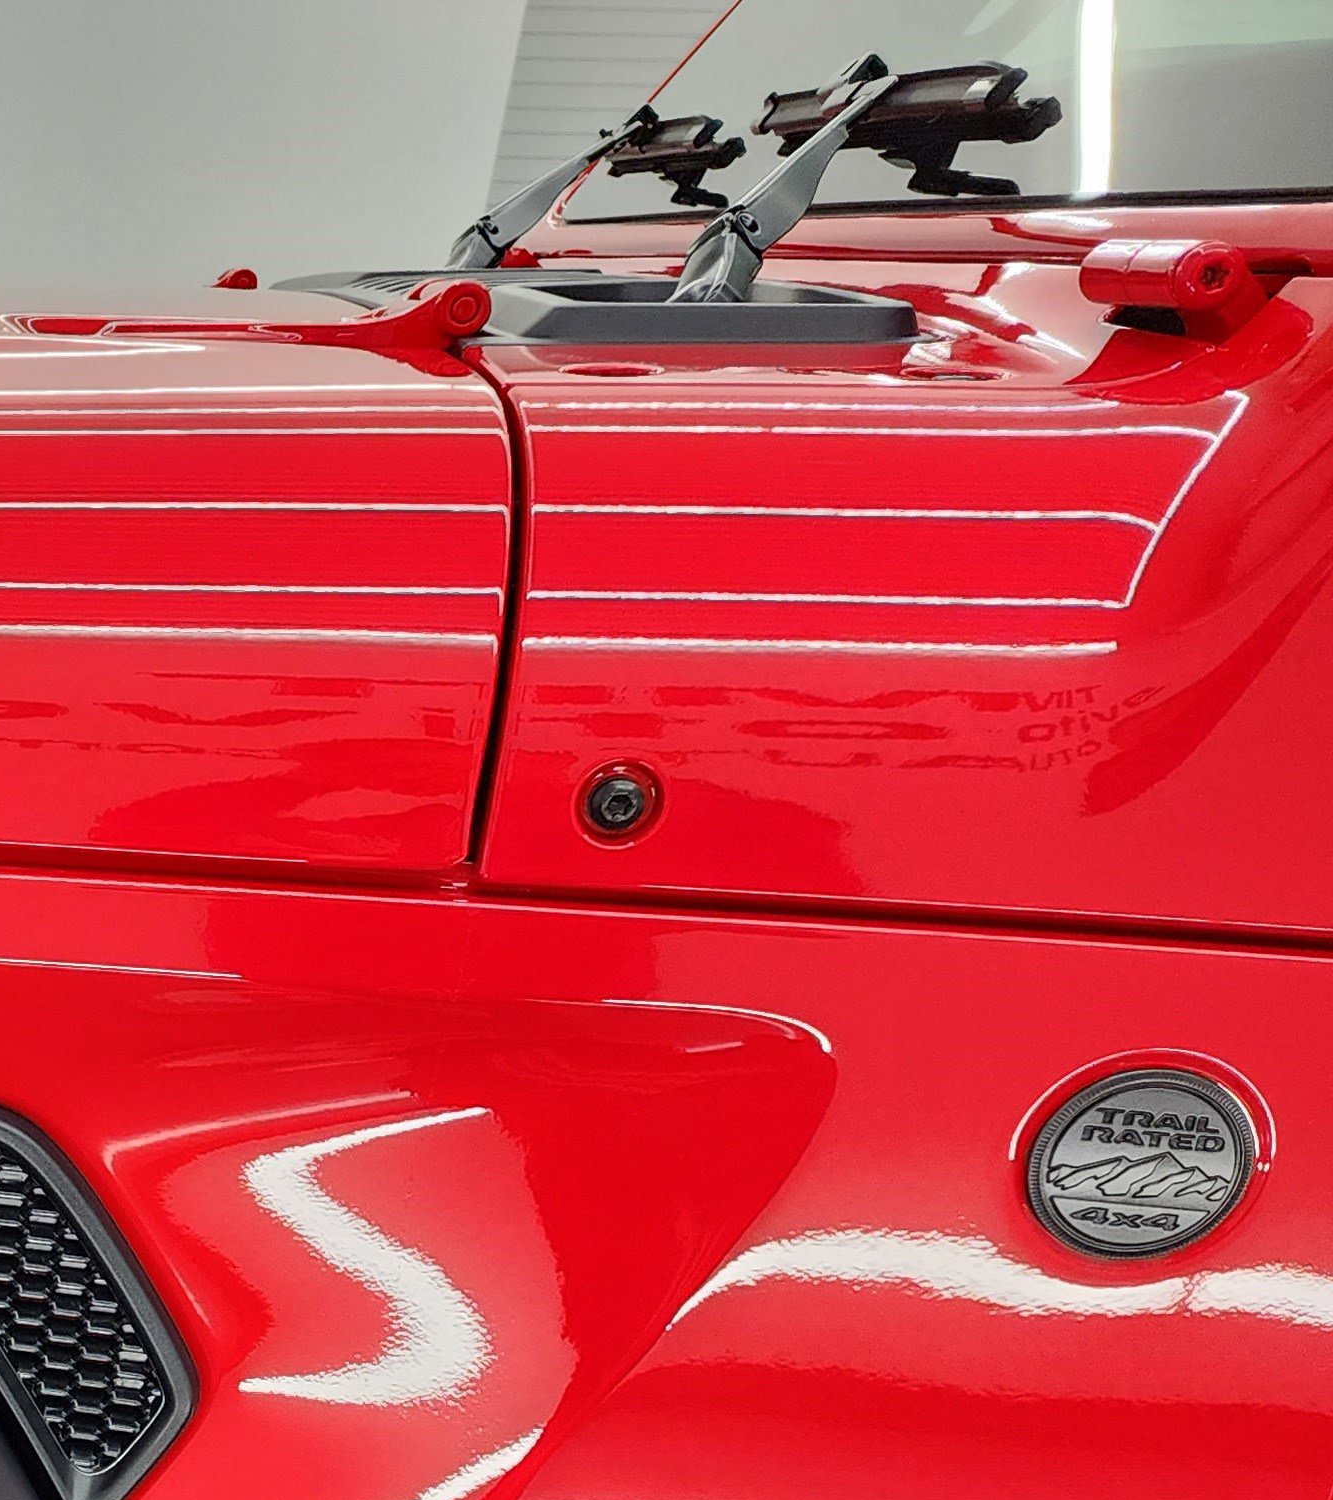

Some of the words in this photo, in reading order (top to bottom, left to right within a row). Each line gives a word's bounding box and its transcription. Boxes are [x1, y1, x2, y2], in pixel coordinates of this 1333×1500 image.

[1095, 1106, 1220, 1135] TRAIL
[1082, 1124, 1226, 1153] RATED
[1069, 1206, 1180, 1231] 4x4
